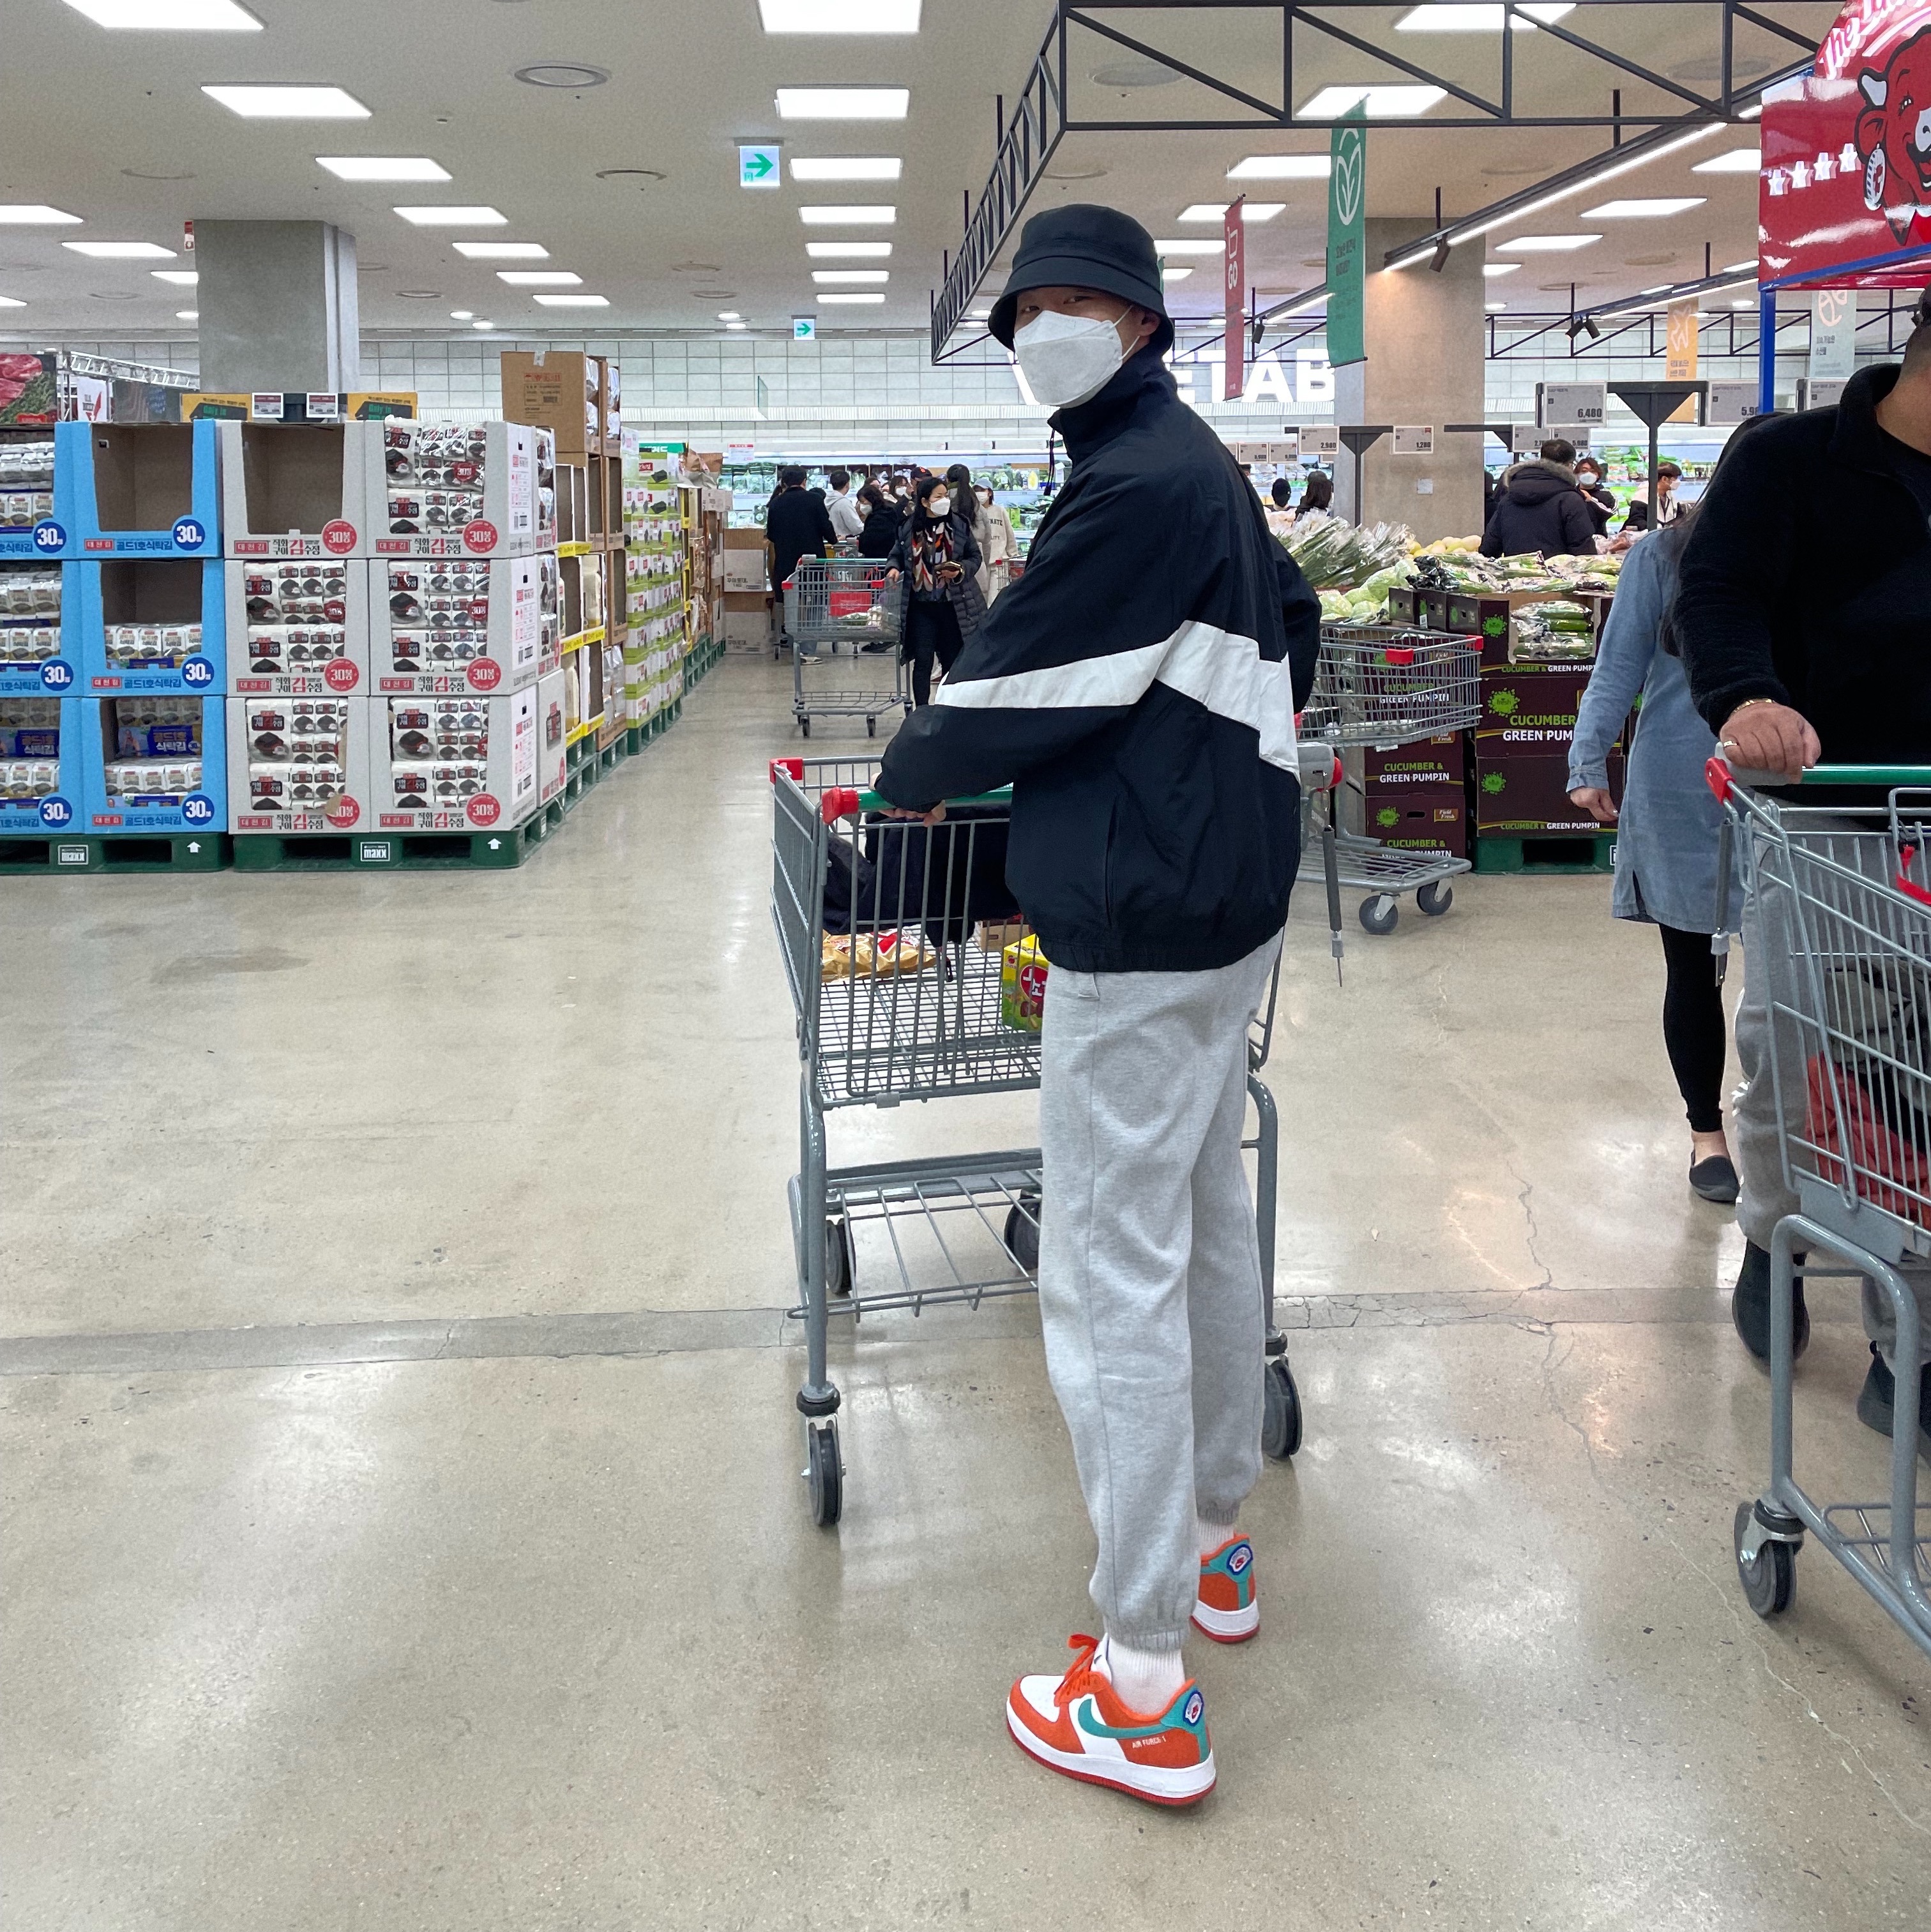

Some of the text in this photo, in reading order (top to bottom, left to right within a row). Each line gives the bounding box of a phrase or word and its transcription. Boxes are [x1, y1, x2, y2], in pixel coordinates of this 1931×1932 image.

[1229, 261, 1238, 290] GO
[1578, 408, 1602, 418] 6,480
[289, 539, 303, 555] 김
[431, 538, 444, 554] 김
[292, 678, 306, 693] 김
[435, 676, 448, 692] 김
[1510, 715, 1576, 726] CUCUMBER
[1503, 730, 1573, 741] GREEN PUM
[1384, 762, 1435, 772] CUCUMBER
[1379, 773, 1450, 782] GREEN PUMPIN
[293, 814, 307, 830] 김
[434, 812, 448, 828] 김
[1387, 839, 1437, 848] CUCUMBER
[364, 849, 387, 858] maxx
[1132, 1740, 1142, 1749] AIR
[1142, 1737, 1162, 1747] FORCE
